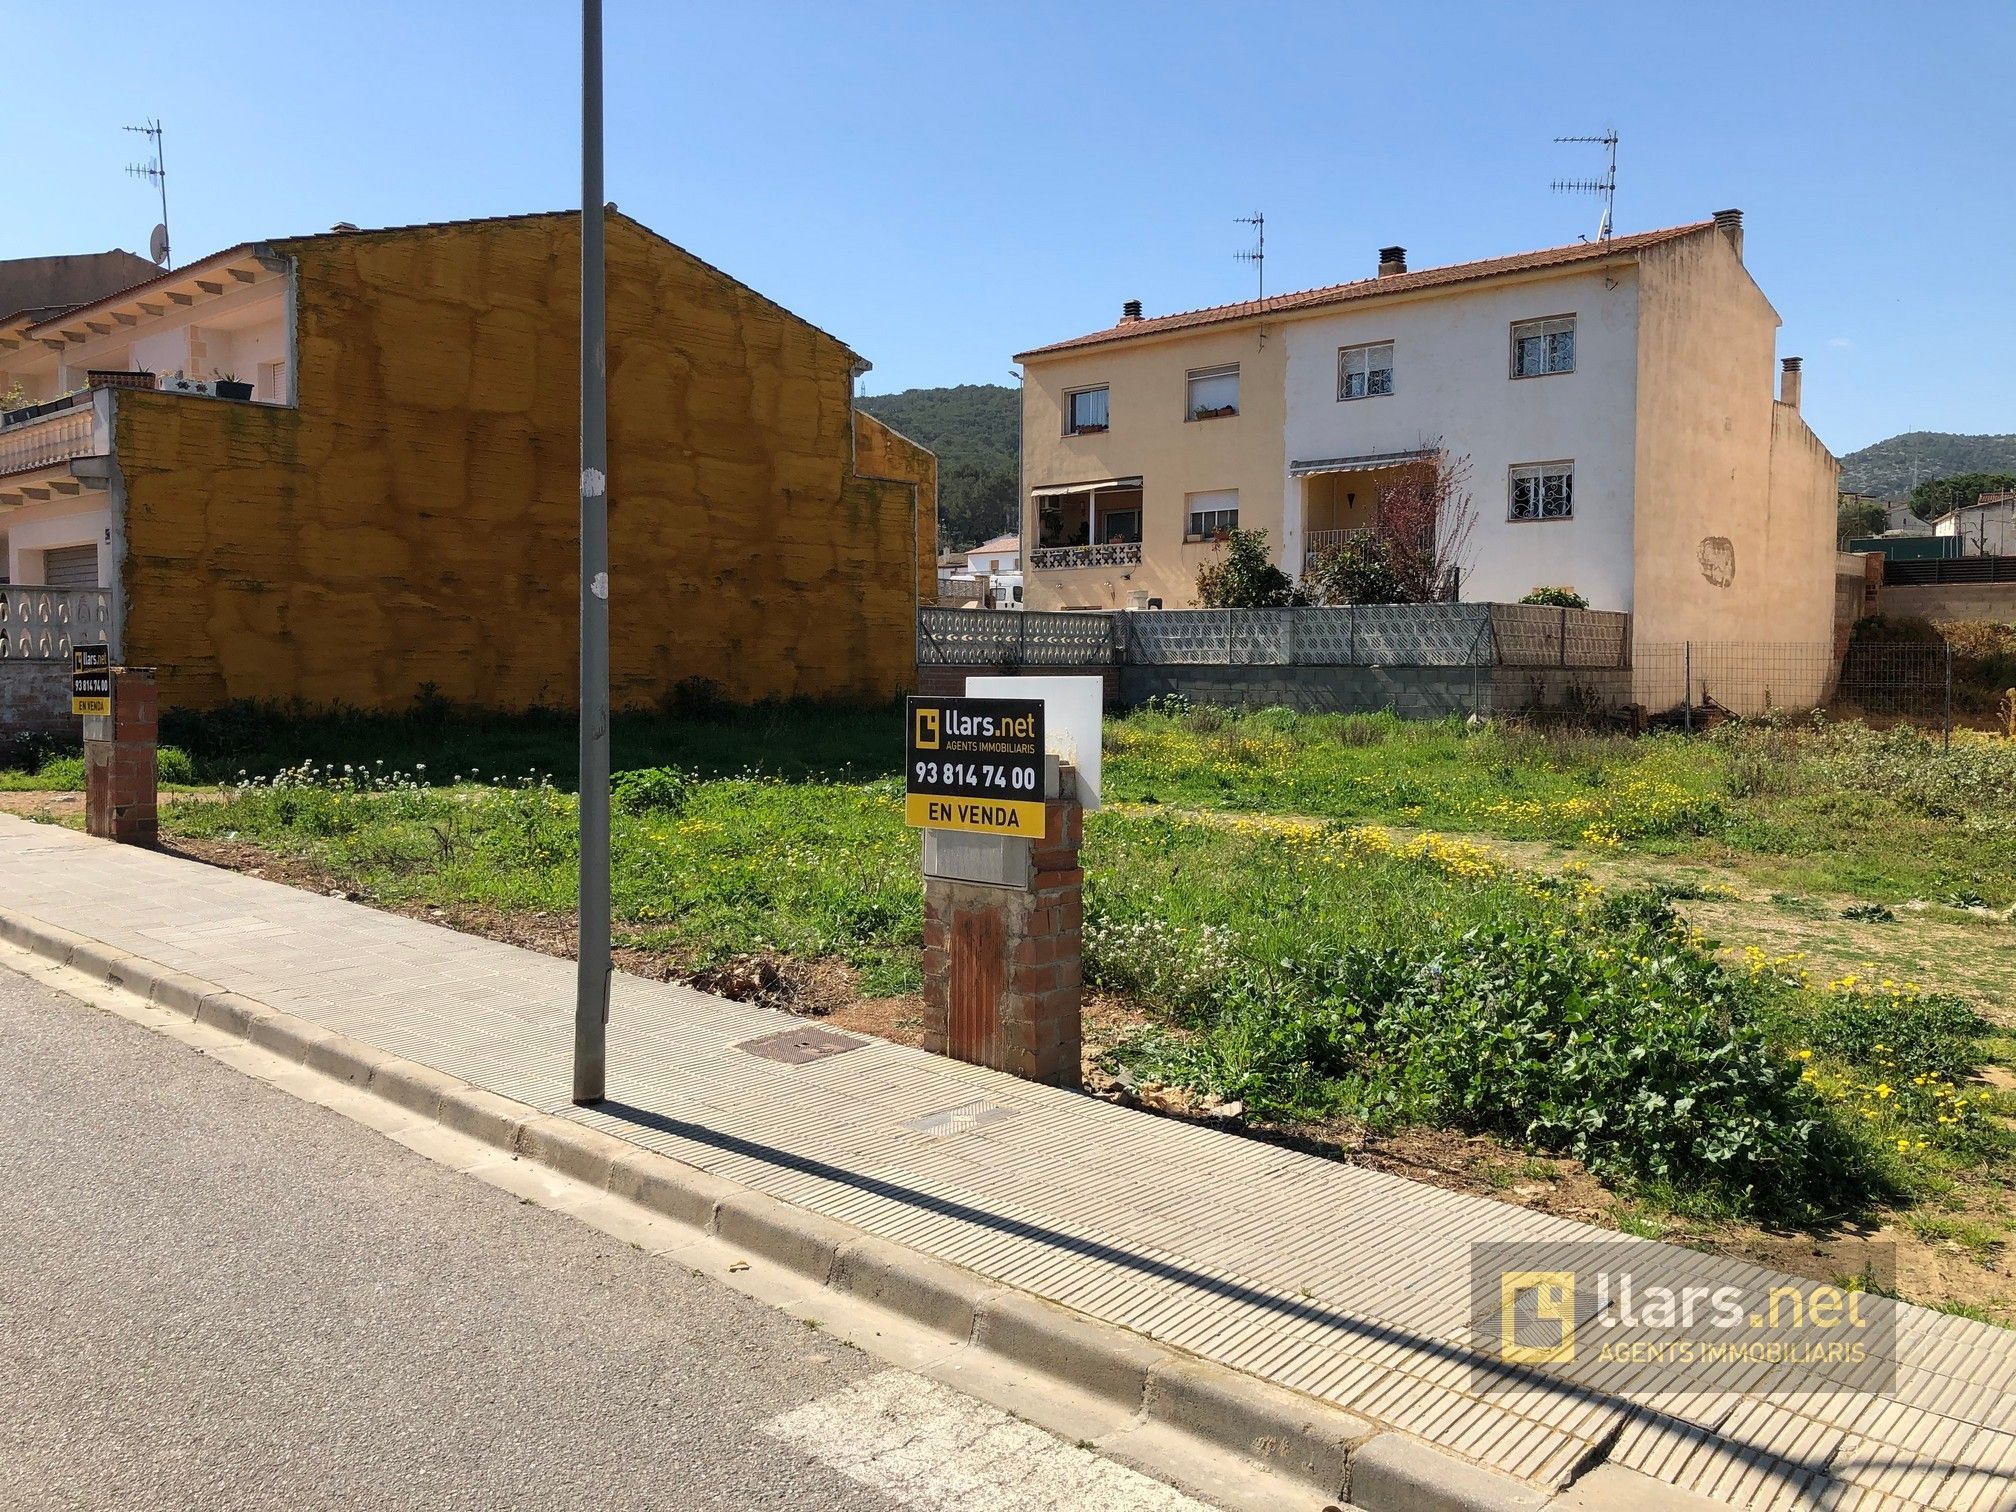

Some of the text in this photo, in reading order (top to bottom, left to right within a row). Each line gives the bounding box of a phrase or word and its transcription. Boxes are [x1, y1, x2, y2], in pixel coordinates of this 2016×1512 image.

[83, 652, 106, 665] llars.net
[75, 680, 108, 691] 93 814 74 00
[79, 701, 104, 711] EN VENDA
[945, 709, 1035, 738] llars.net
[946, 741, 1035, 754] AGENTS IMMOBILIARIS
[915, 762, 1035, 790] 93 814 74 00
[928, 802, 1019, 828] EN VENDA
